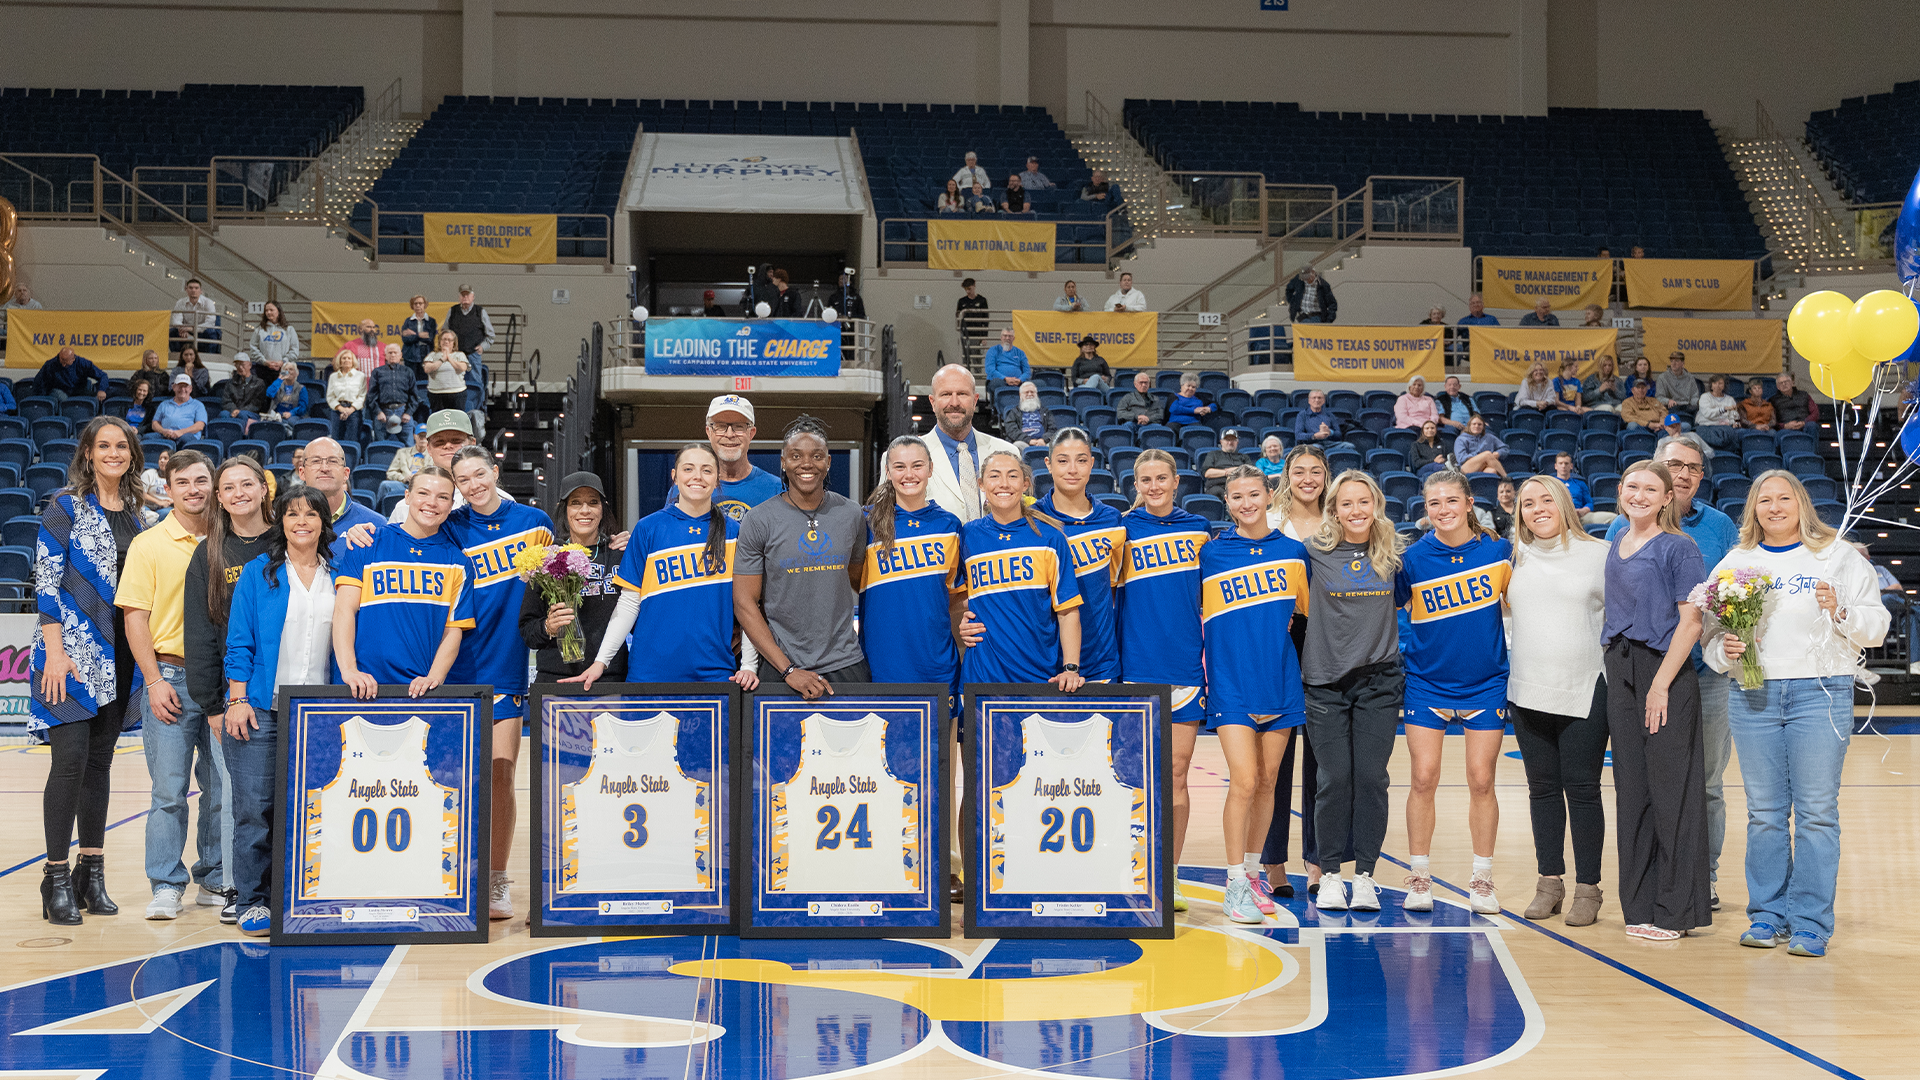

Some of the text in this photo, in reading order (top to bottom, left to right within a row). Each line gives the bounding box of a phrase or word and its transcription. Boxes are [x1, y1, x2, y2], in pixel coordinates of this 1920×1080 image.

[446, 224, 532, 237] CATE BOLDRICK
[469, 236, 512, 249] FAMILY
[936, 239, 1048, 253] CITY NATIONAL BANK
[1497, 269, 1599, 282] PURE MANAGEMENT &
[1662, 278, 1720, 289] SAM'S CLUB
[1514, 284, 1581, 296] BOOKKEEPING
[1200, 315, 1219, 324] 112
[1614, 320, 1631, 328] 112
[33, 333, 145, 347] KAY & ALEX DECUIR
[653, 338, 833, 359] LEADING THE CHARGE
[1299, 337, 1438, 351] TRANS TEXAS SOUTHWEST
[1677, 339, 1747, 351] SONORA BANK
[1329, 358, 1405, 370] CREDIT UNION
[1494, 349, 1520, 361] PAUL
[1523, 350, 1531, 362] &
[1534, 350, 1556, 361] PAM
[735, 377, 752, 391] EXIT
[472, 540, 527, 580] ELLE
[876, 541, 946, 576] BELLES
[1071, 536, 1113, 570] LLES
[1131, 538, 1197, 572] BELLES
[803, 564, 845, 573] REMEMBER
[969, 555, 1034, 590] BELLES
[372, 568, 445, 597] BELLES
[1219, 568, 1288, 605] BELLES
[1787, 573, 1821, 595] State
[1345, 590, 1391, 598] REMEMBER
[1420, 574, 1494, 614] BELLES
[348, 778, 420, 803] Angelo State
[600, 774, 671, 799] Angelo State
[809, 774, 878, 800] Angelo State
[1033, 776, 1103, 802] Angelo State
[350, 806, 412, 854] 00
[622, 802, 650, 850] 3
[815, 802, 874, 851] 24
[1038, 805, 1096, 854] 20
